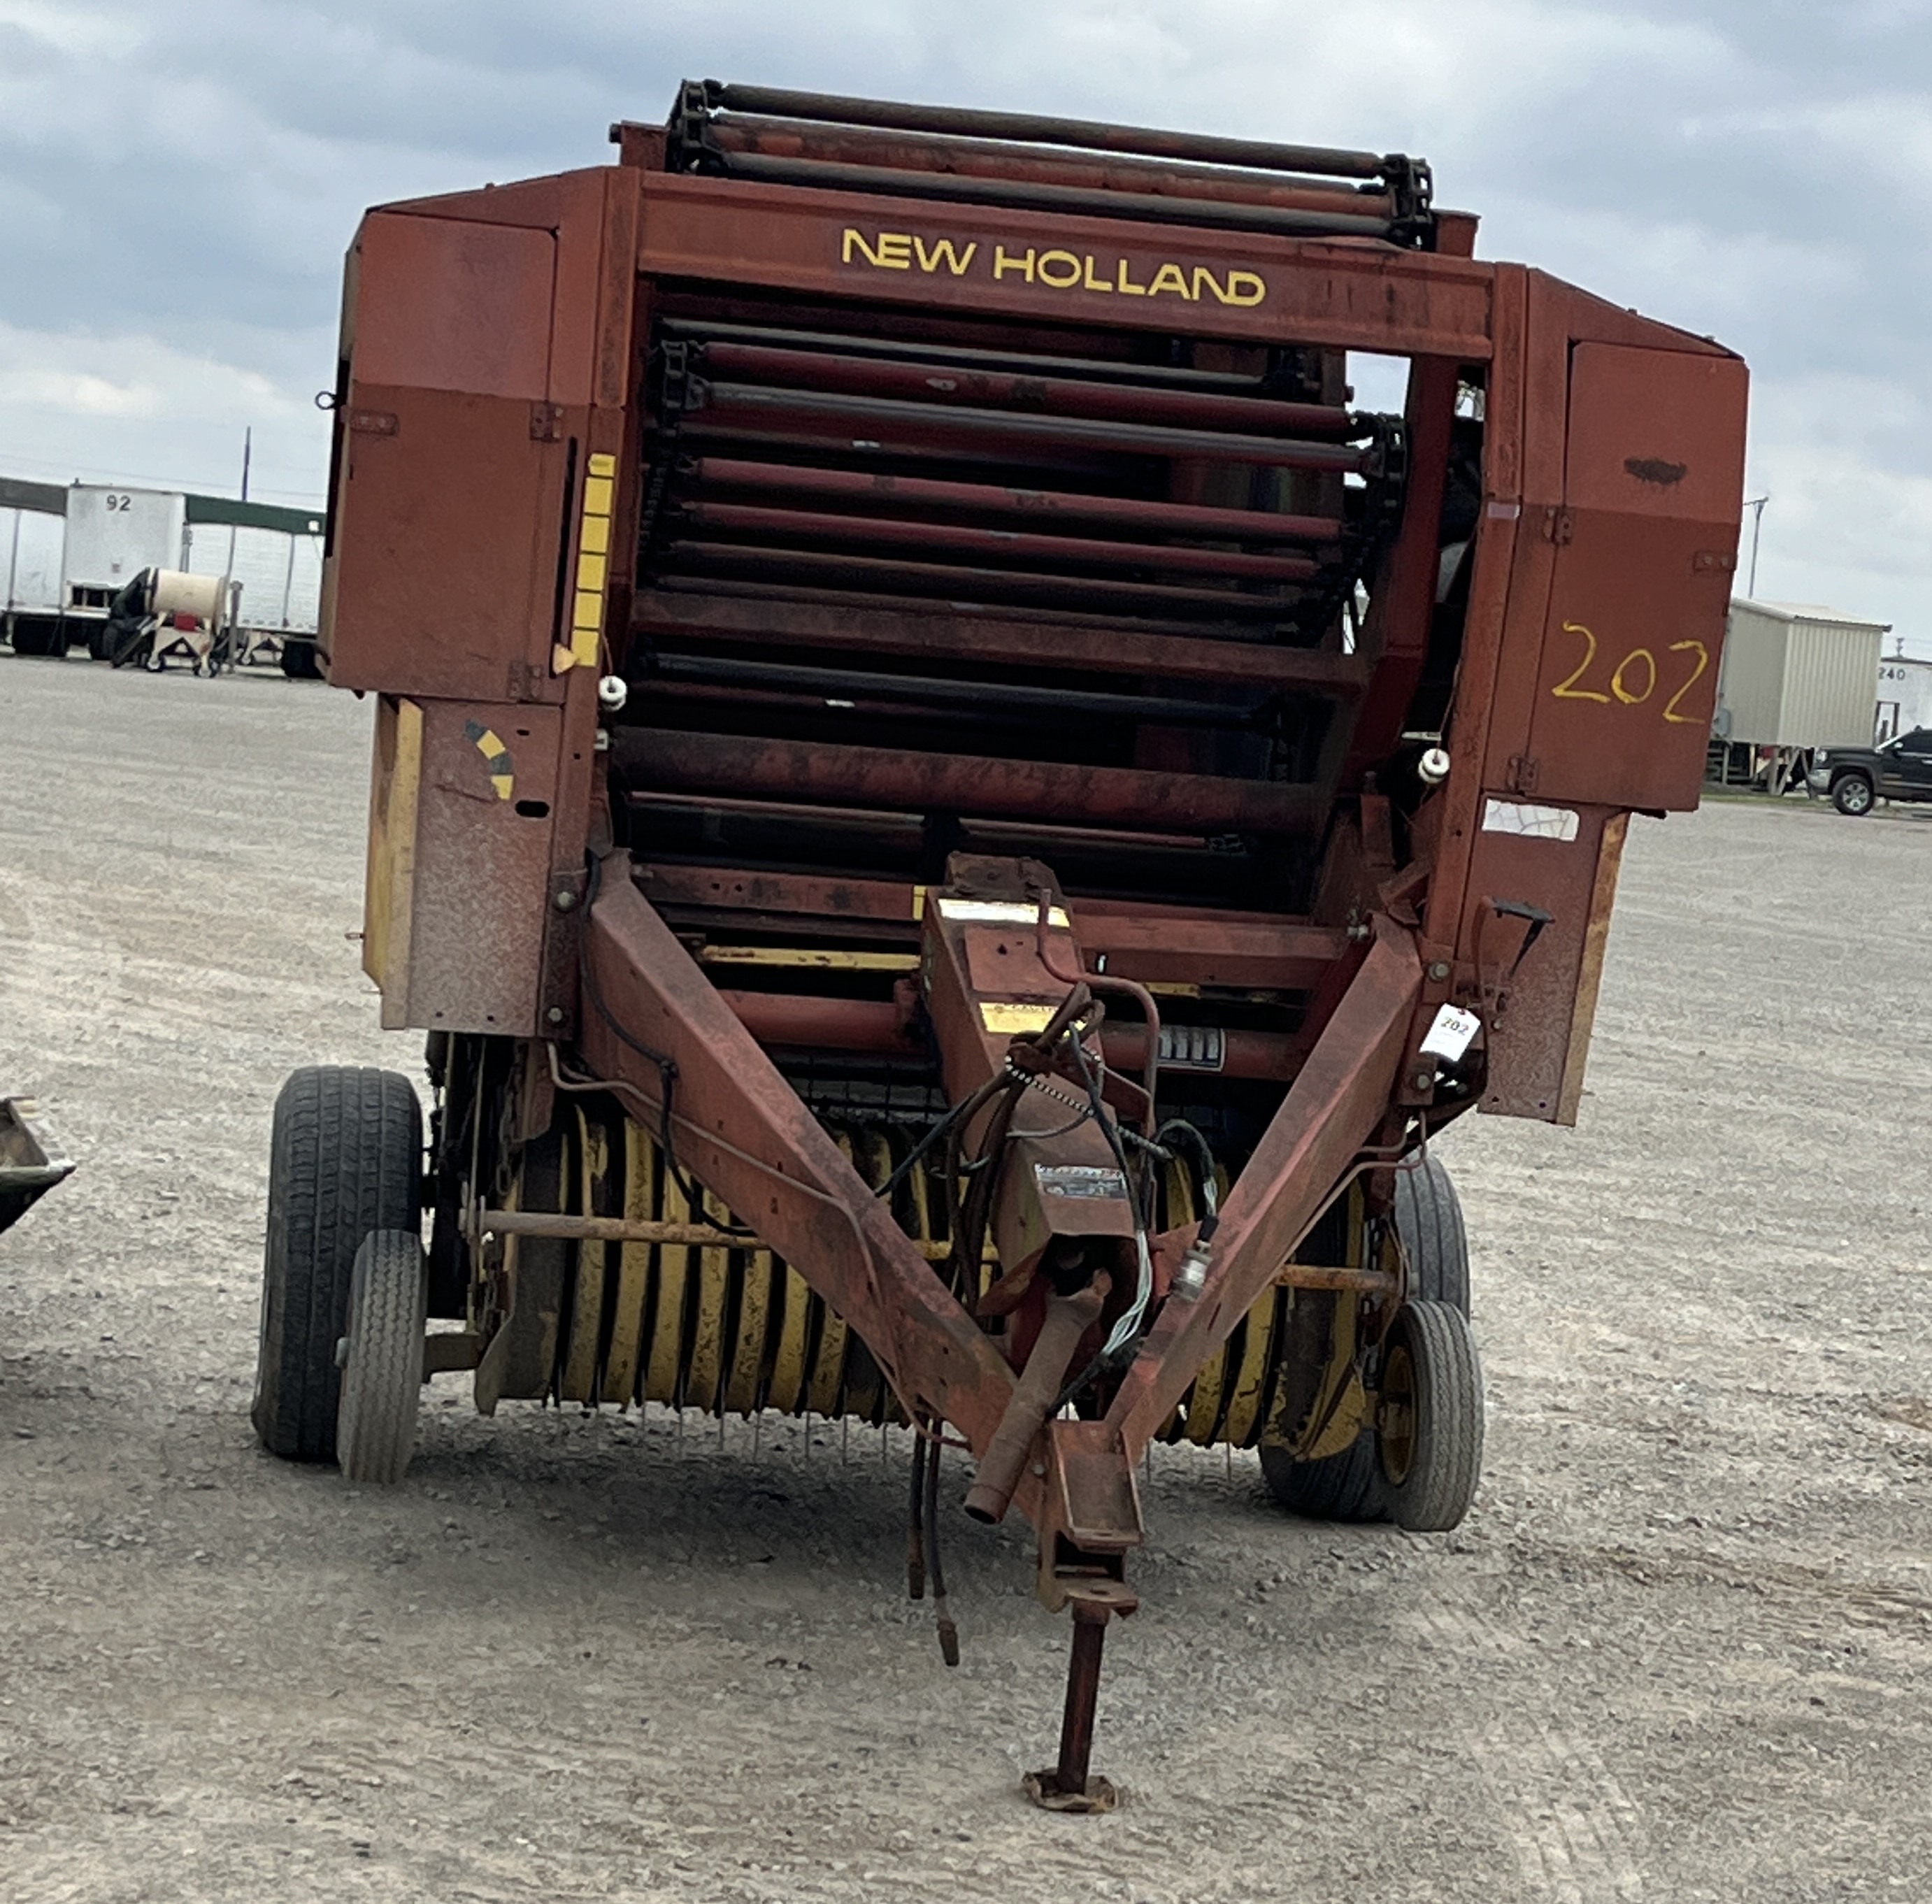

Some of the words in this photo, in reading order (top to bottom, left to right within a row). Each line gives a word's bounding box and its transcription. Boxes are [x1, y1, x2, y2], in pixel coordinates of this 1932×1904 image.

[841, 228, 977, 275] NEW
[993, 245, 1266, 306] HOLLAND
[106, 494, 131, 511] 92
[1552, 620, 1708, 724] 202
[1878, 666, 1906, 681] 240
[1440, 1016, 1469, 1036] 202
